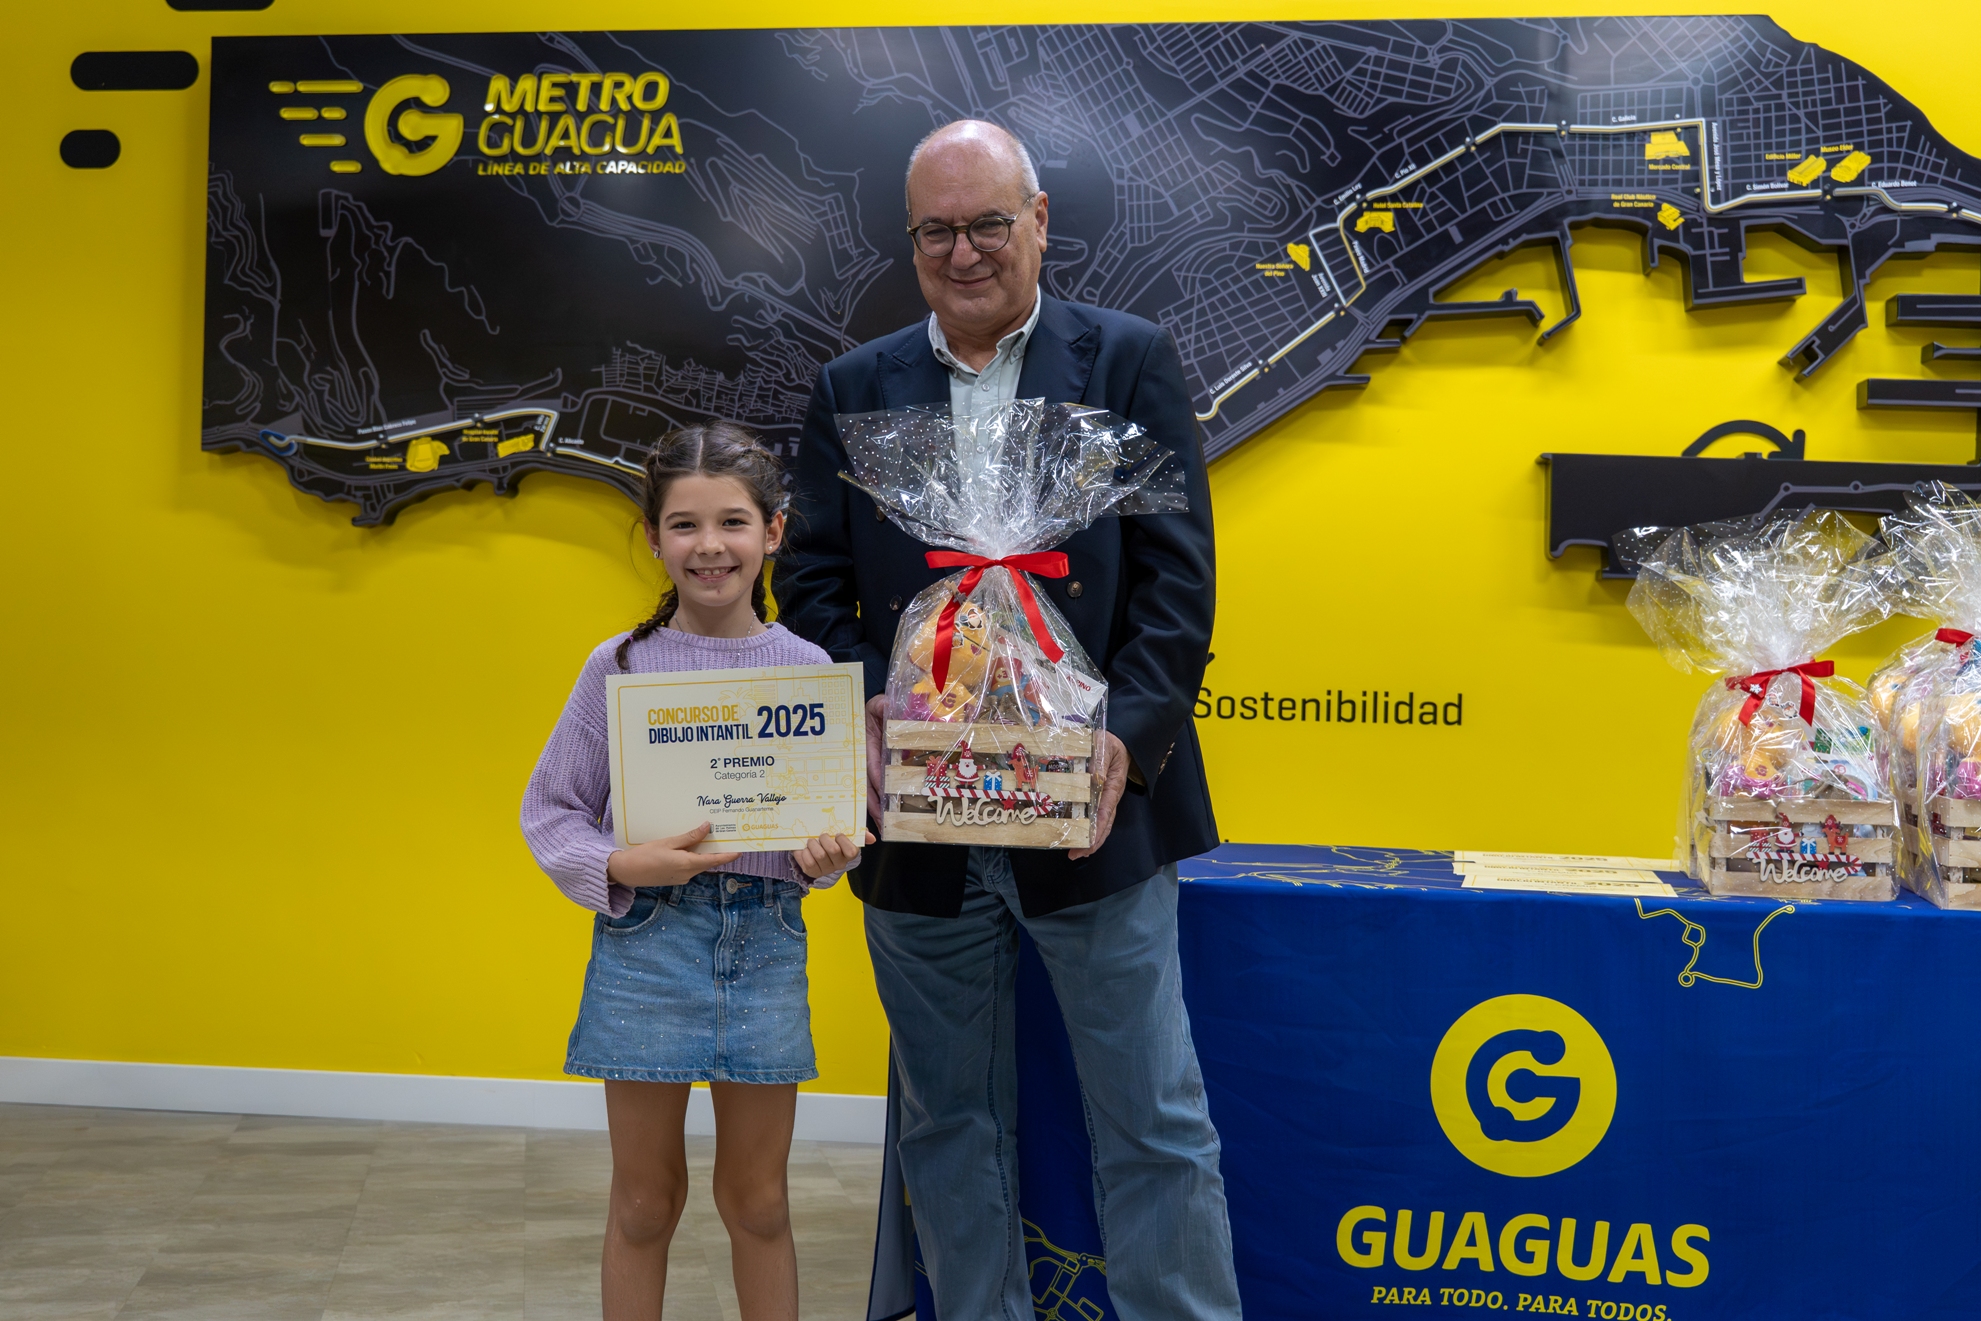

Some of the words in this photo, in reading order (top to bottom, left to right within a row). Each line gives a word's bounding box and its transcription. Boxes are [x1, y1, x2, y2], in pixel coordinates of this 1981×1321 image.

[484, 71, 670, 113] METRO
[1611, 115, 1618, 123] C.
[1618, 114, 1637, 123] Galicia
[477, 112, 684, 156] GUAGUA
[1711, 122, 1719, 143] Avenida
[1786, 152, 1802, 160] Miller
[1839, 144, 1854, 152] Elder
[477, 160, 525, 175] LÍNEA
[528, 161, 550, 175] DE
[553, 160, 592, 175] ALTA
[596, 160, 686, 174] CAPACIDAD
[1671, 163, 1691, 171] Central
[1878, 180, 1900, 189] Eduardo
[1215, 380, 1226, 391] Luis
[1240, 361, 1253, 374] Silva
[648, 706, 720, 726] CONCURSO
[721, 704, 740, 722] DE
[1192, 686, 1463, 726] Sostenibilidad
[756, 703, 826, 739] 2025
[648, 726, 694, 744] DIBUJO
[723, 755, 775, 769] PREMIO
[714, 769, 757, 782] Categoría
[759, 769, 766, 779] 2
[696, 795, 721, 807] Nara
[723, 793, 755, 809] Guerra
[756, 792, 787, 806] Vallejo
[927, 795, 1038, 827] Welcome
[750, 823, 779, 831] GUAGUAS
[1752, 858, 1850, 884] Welcome
[1336, 1204, 1711, 1288] GUAGUAS
[1370, 1285, 1433, 1306] PARA
[1439, 1287, 1509, 1311] TODO.
[1516, 1292, 1580, 1316] PARA
[1586, 1299, 1674, 1321] TODOS.
